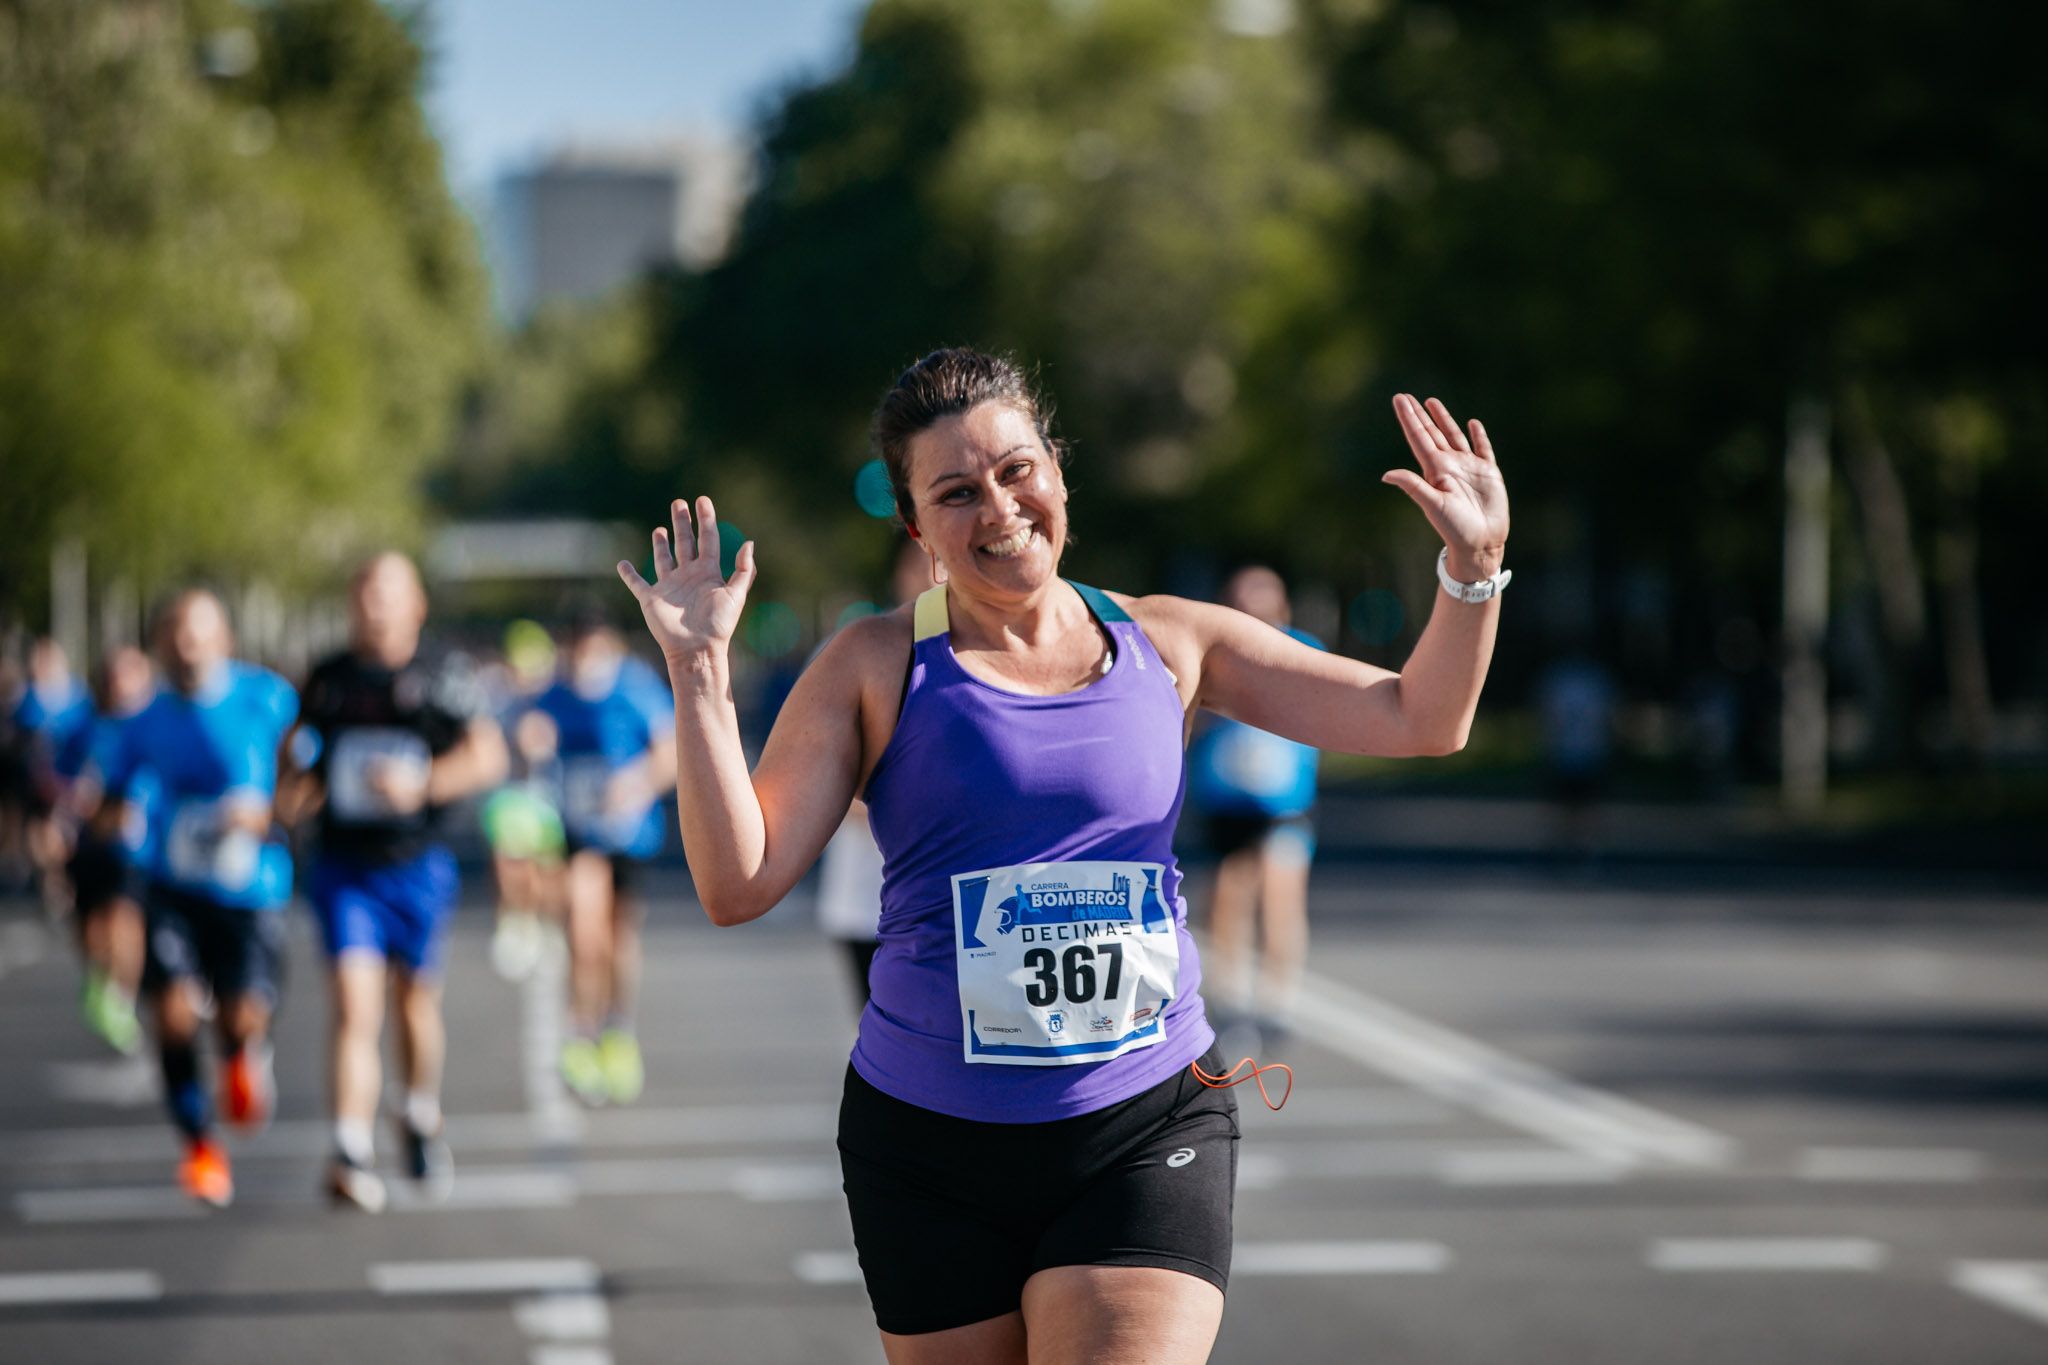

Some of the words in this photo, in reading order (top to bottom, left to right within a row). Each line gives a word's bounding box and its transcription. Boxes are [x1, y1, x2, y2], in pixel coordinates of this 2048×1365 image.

[1031, 882, 1069, 890] CARRERA
[1032, 891, 1126, 908] BOMBEROS
[1072, 905, 1087, 920] de
[1088, 904, 1130, 919] MADRID
[1022, 922, 1132, 943] DECIMAS
[1023, 943, 1124, 1007] 367
